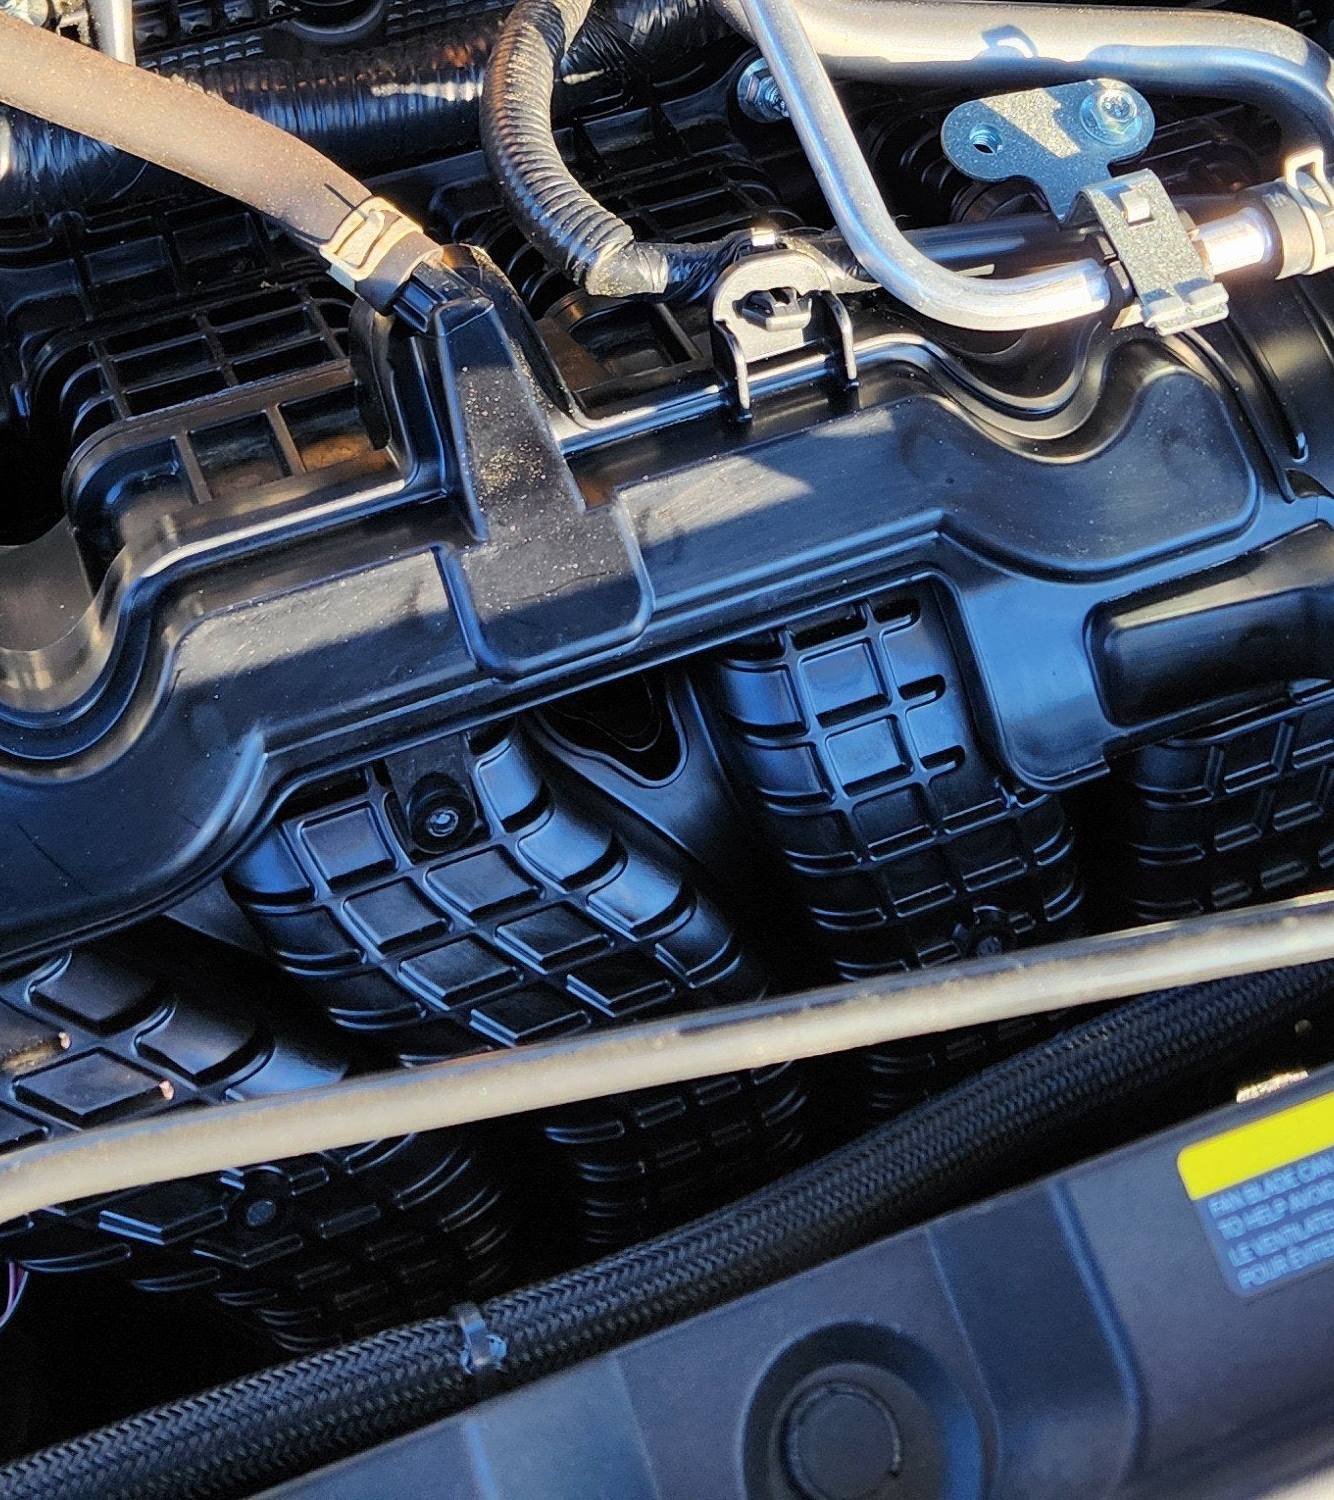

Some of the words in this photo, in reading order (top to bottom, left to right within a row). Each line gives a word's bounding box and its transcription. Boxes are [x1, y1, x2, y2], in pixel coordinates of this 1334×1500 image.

[1207, 1188, 1245, 1218] FAN
[1216, 1214, 1246, 1241] TO
[1240, 1196, 1290, 1231] HELP
[1227, 1240, 1256, 1267] LE
[1236, 1254, 1290, 1290] POUR
